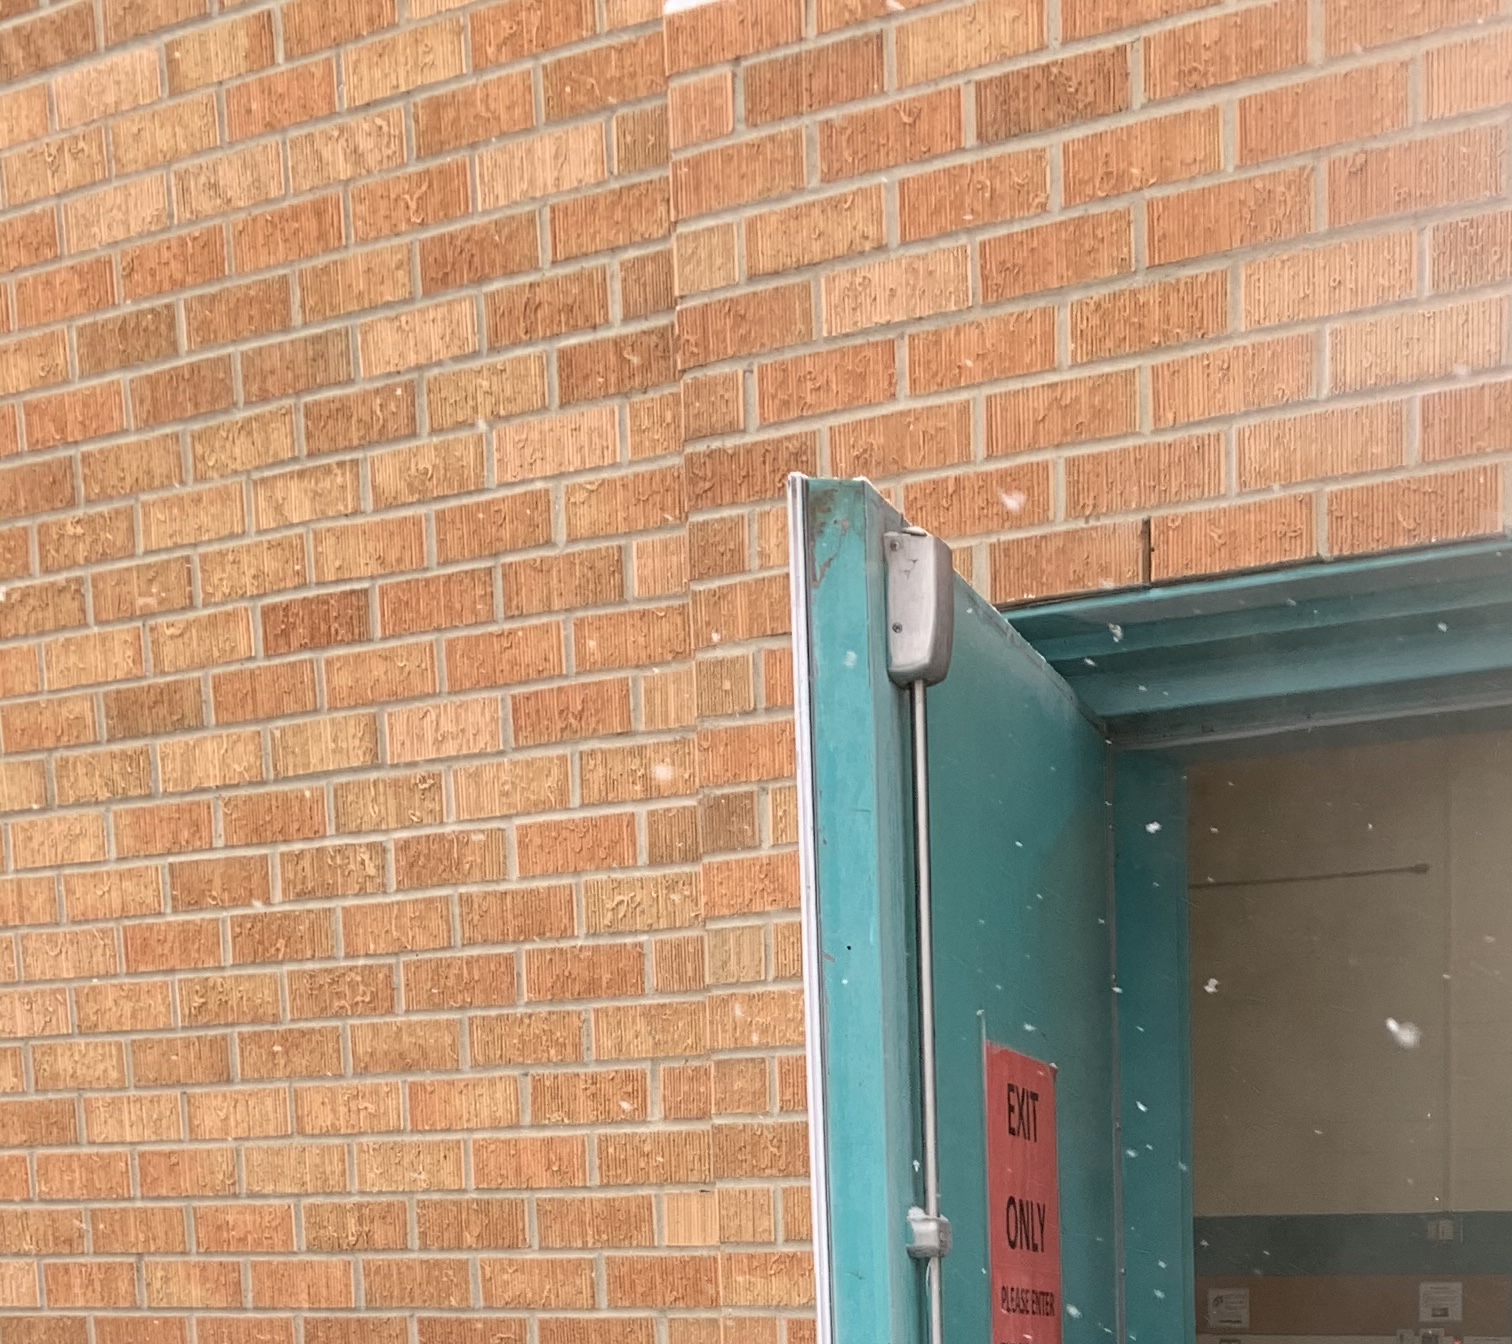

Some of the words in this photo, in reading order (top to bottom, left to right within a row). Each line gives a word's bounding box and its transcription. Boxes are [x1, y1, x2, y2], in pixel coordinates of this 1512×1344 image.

[1007, 1083, 1039, 1143] EXIT
[1006, 1196, 1046, 1253] ONLY
[1001, 1285, 1030, 1315] PLEASE
[1031, 1290, 1055, 1317] ENTER
